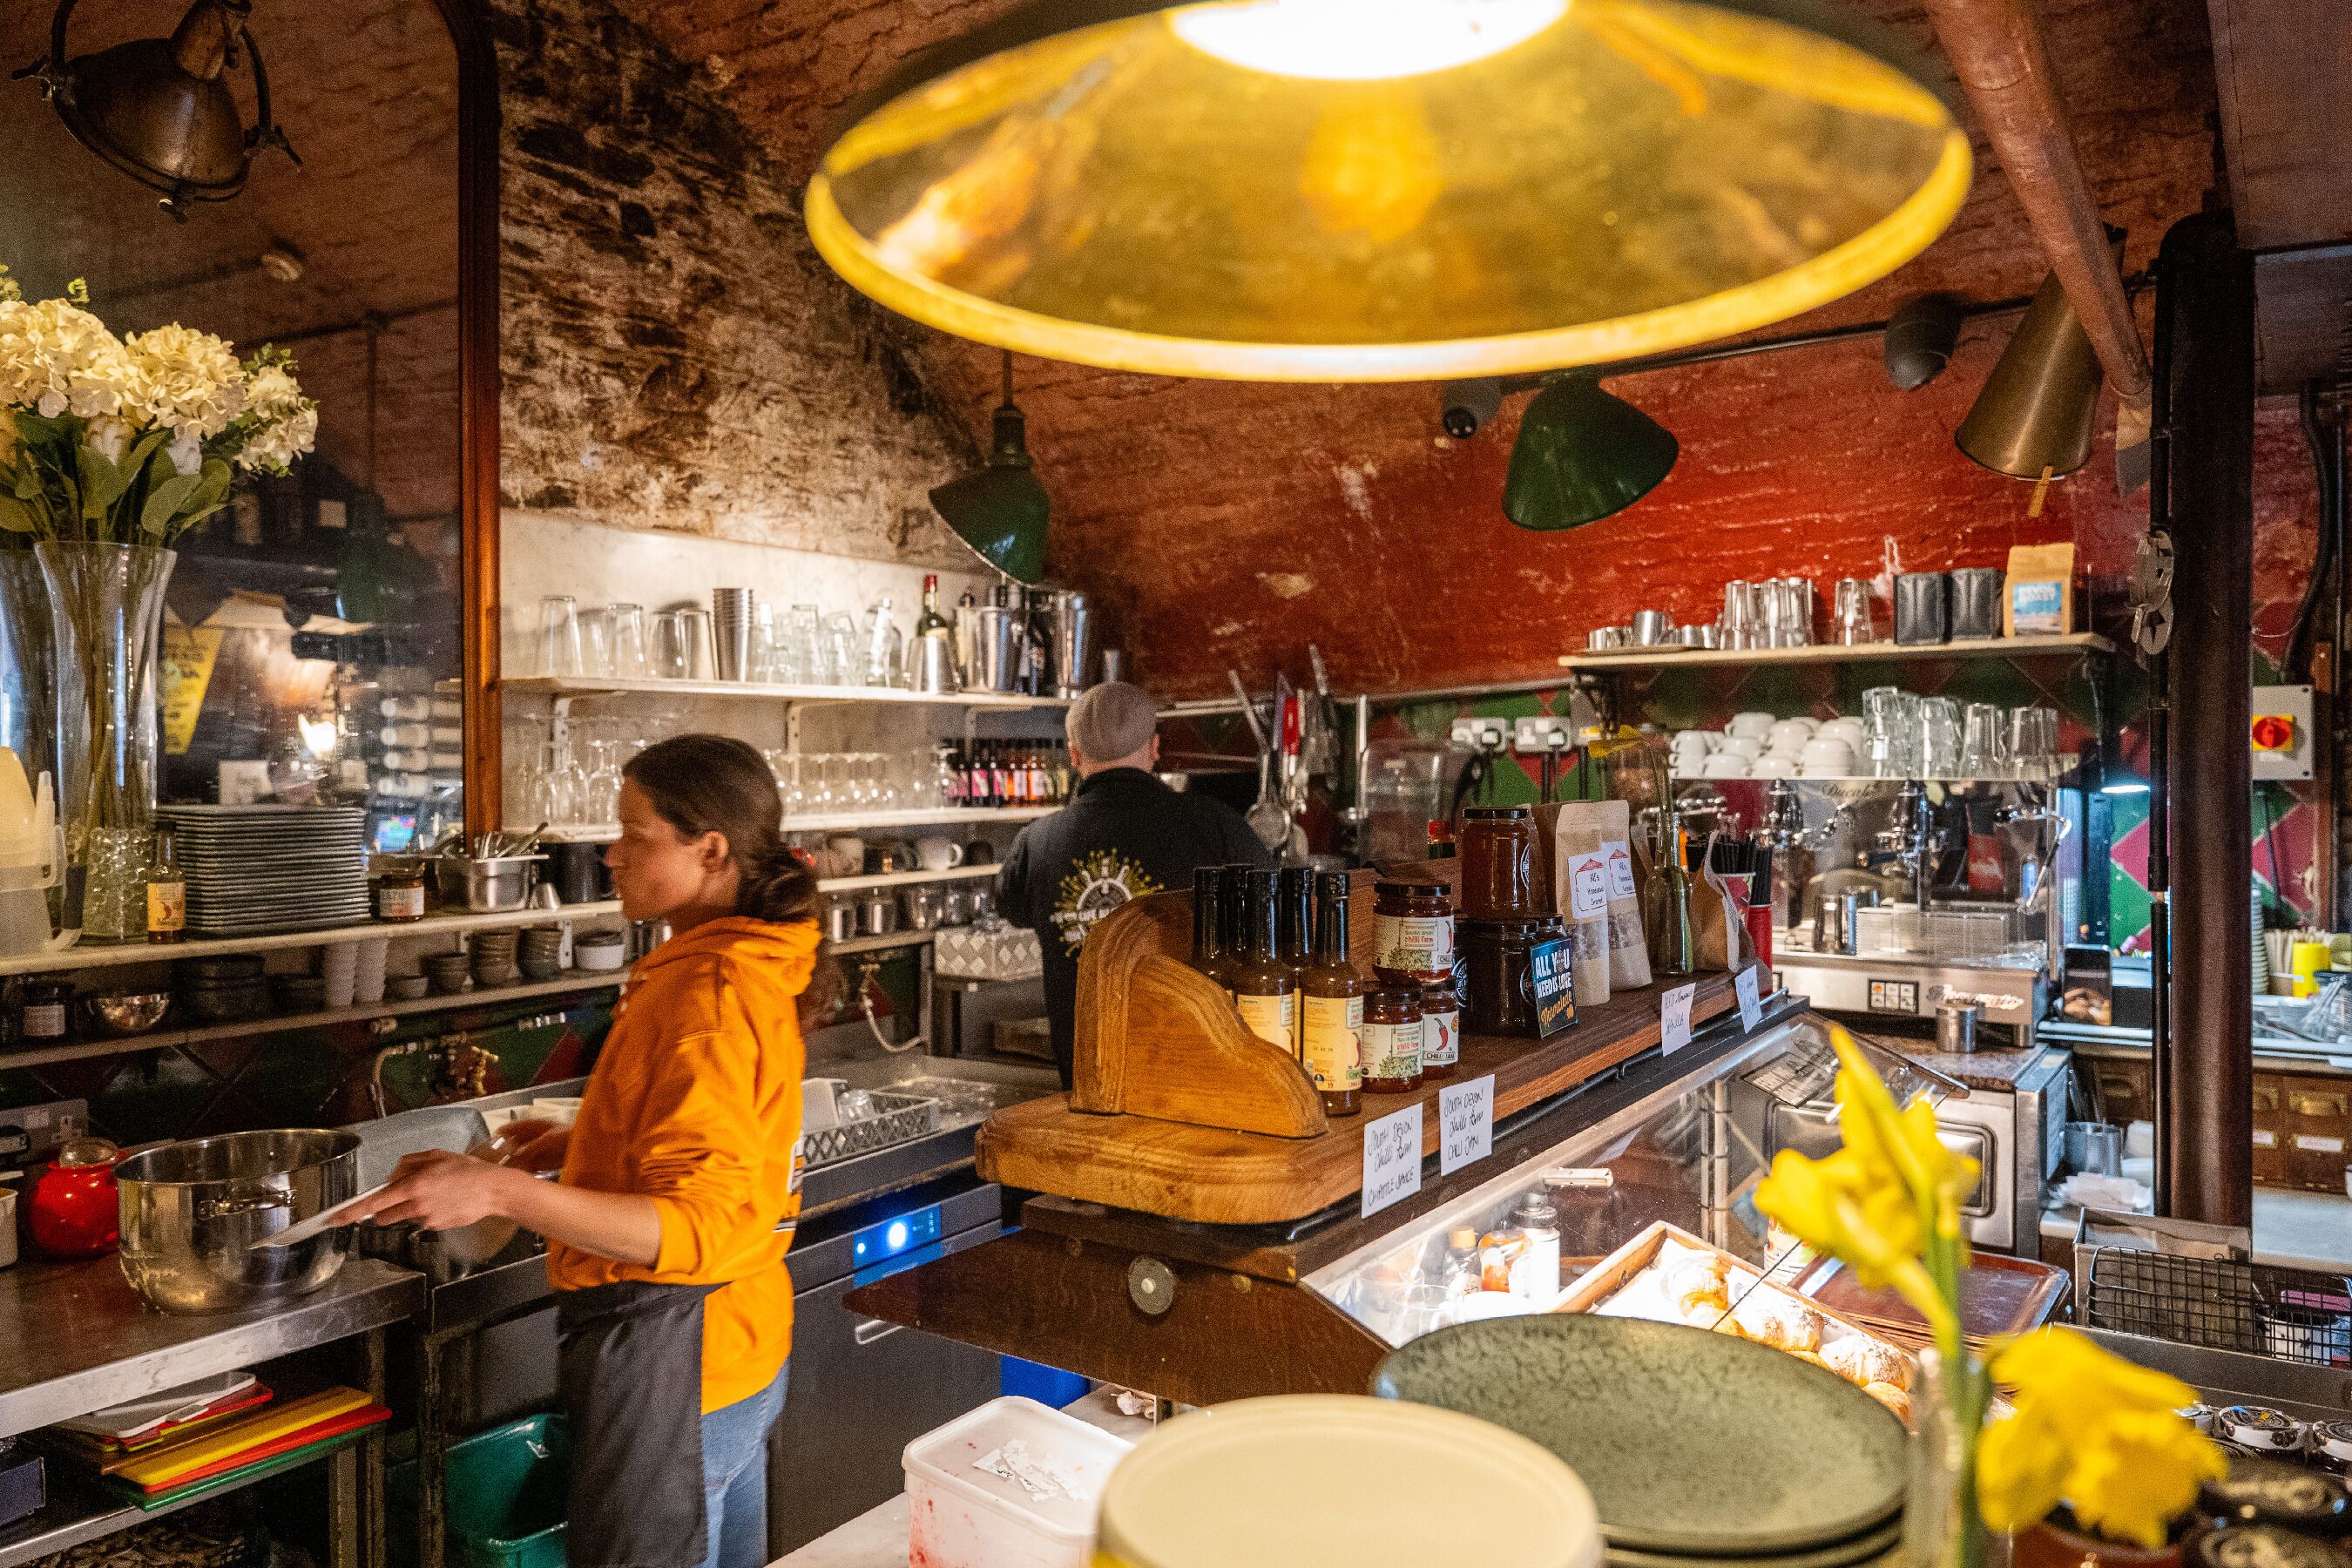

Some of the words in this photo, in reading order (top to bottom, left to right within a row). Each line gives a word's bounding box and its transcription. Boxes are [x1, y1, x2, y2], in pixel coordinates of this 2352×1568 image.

[1535, 955, 1551, 979] ALL
[1537, 978, 1552, 999] NEED
[1552, 975, 1558, 993] IS
[1558, 971, 1572, 990] LOVE
